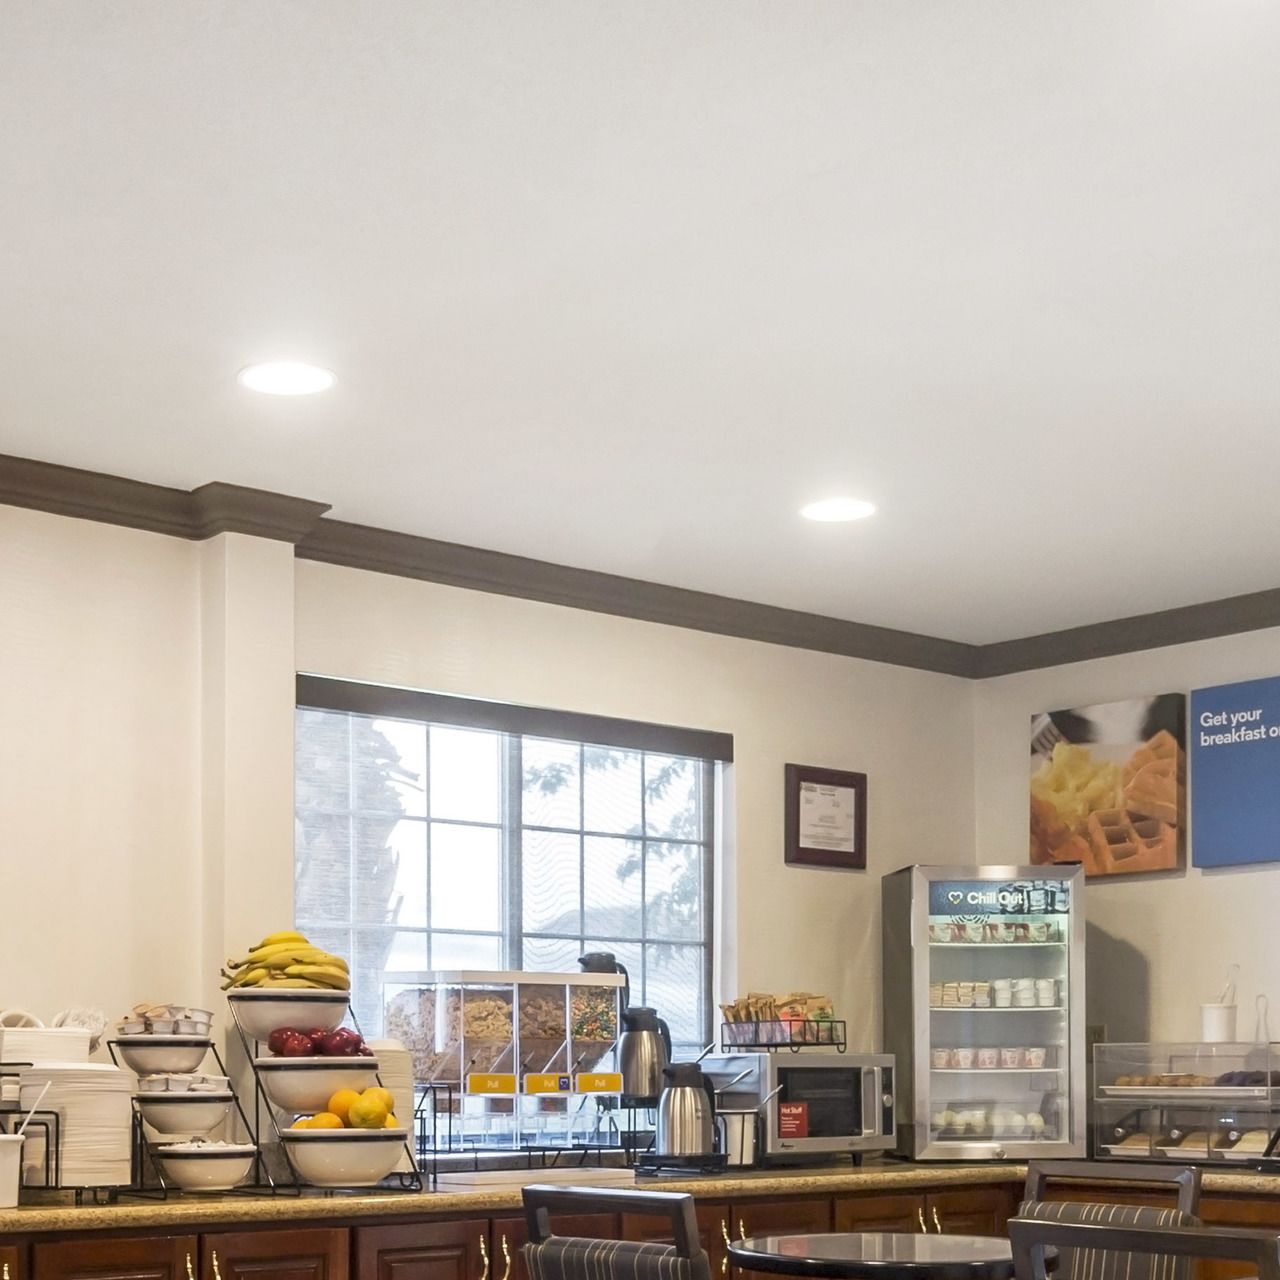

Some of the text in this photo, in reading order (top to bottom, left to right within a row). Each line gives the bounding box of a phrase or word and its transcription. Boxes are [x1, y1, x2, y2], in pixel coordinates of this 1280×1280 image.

[1199, 708, 1263, 728] Get your
[1200, 725, 1267, 747] breakfast
[966, 891, 1024, 905] Chill Out
